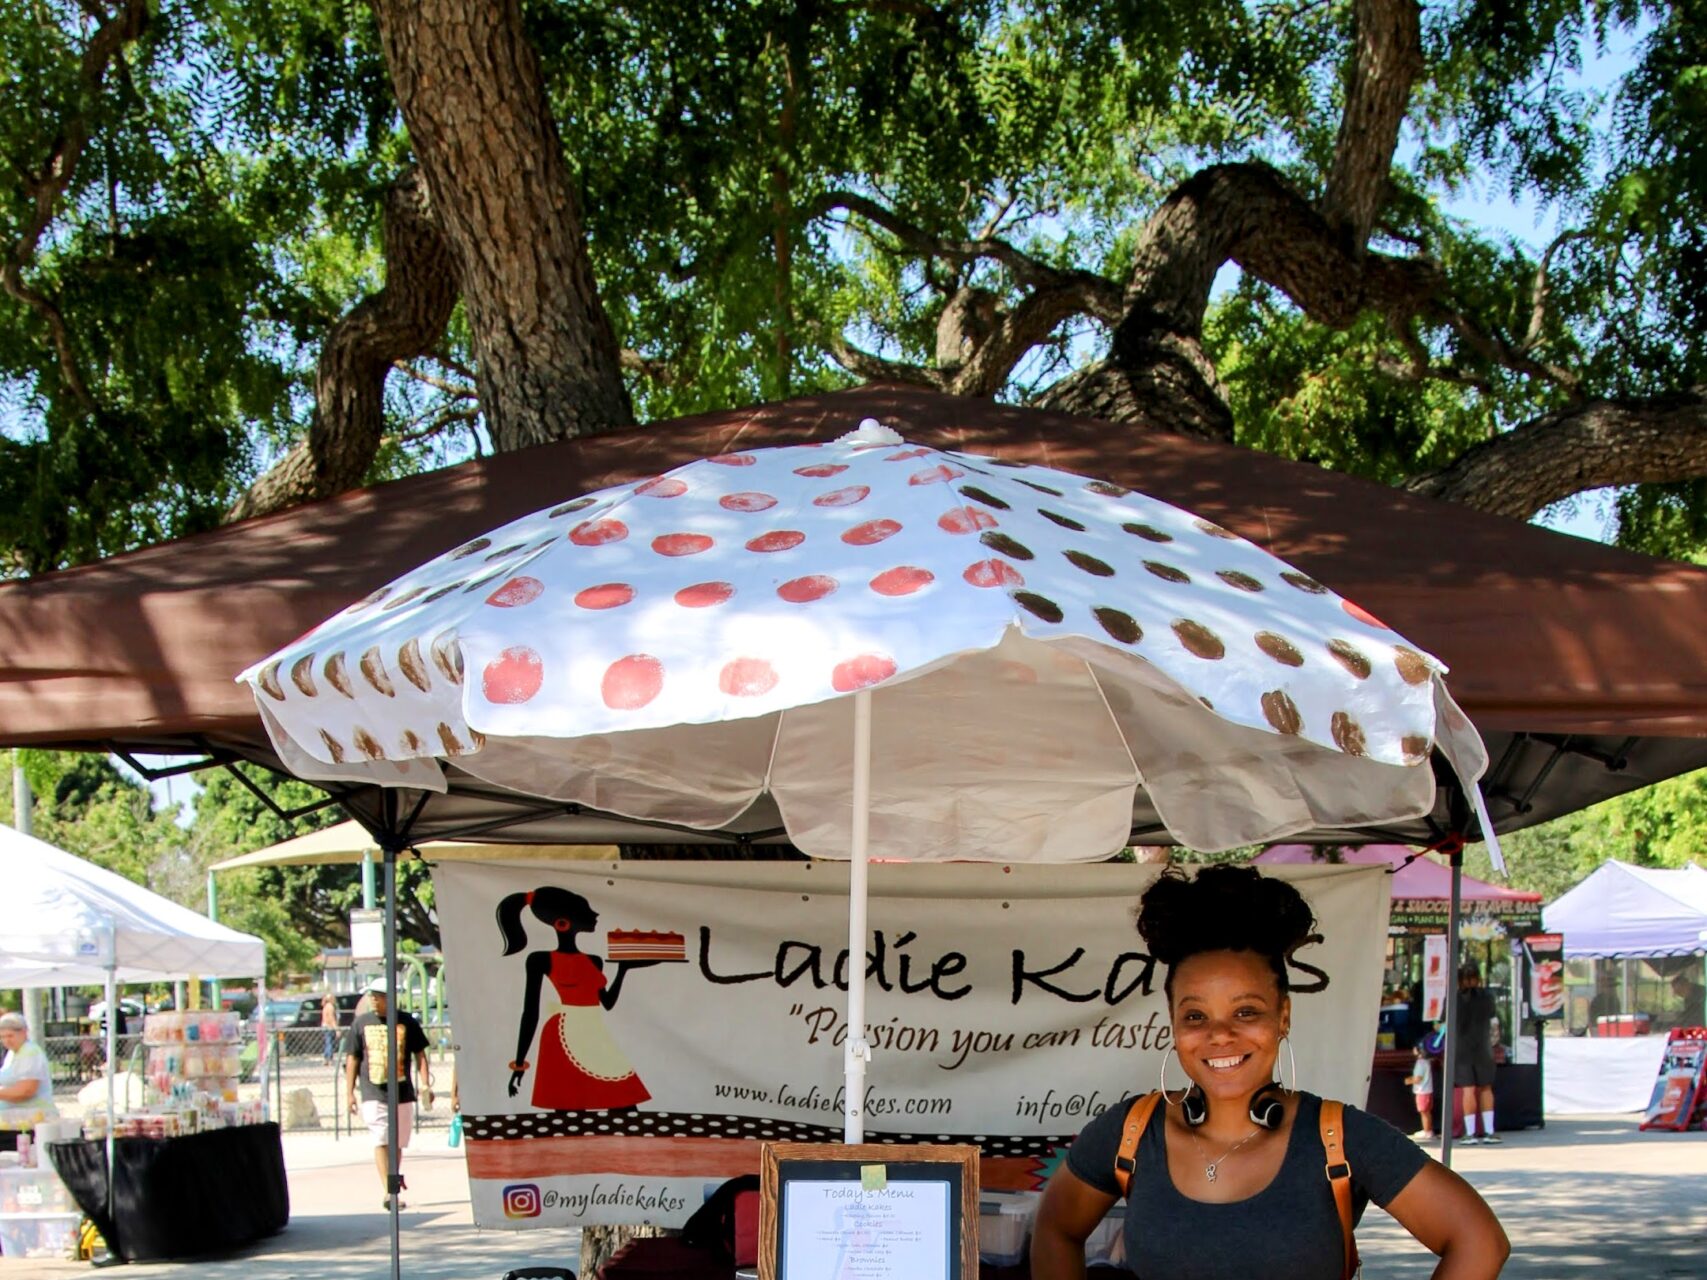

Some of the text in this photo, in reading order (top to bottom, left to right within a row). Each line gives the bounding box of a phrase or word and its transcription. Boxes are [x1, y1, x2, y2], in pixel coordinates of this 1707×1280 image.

[1011, 933, 1331, 1006] Kas
[939, 1028, 1012, 1070] you
[1021, 1026, 1080, 1050] can
[714, 1083, 953, 1117] www.ladiekkes.com
[543, 1183, 686, 1218] @myladiekakes
[878, 1188, 915, 1199] Menu
[849, 1256, 886, 1264] Brownies
